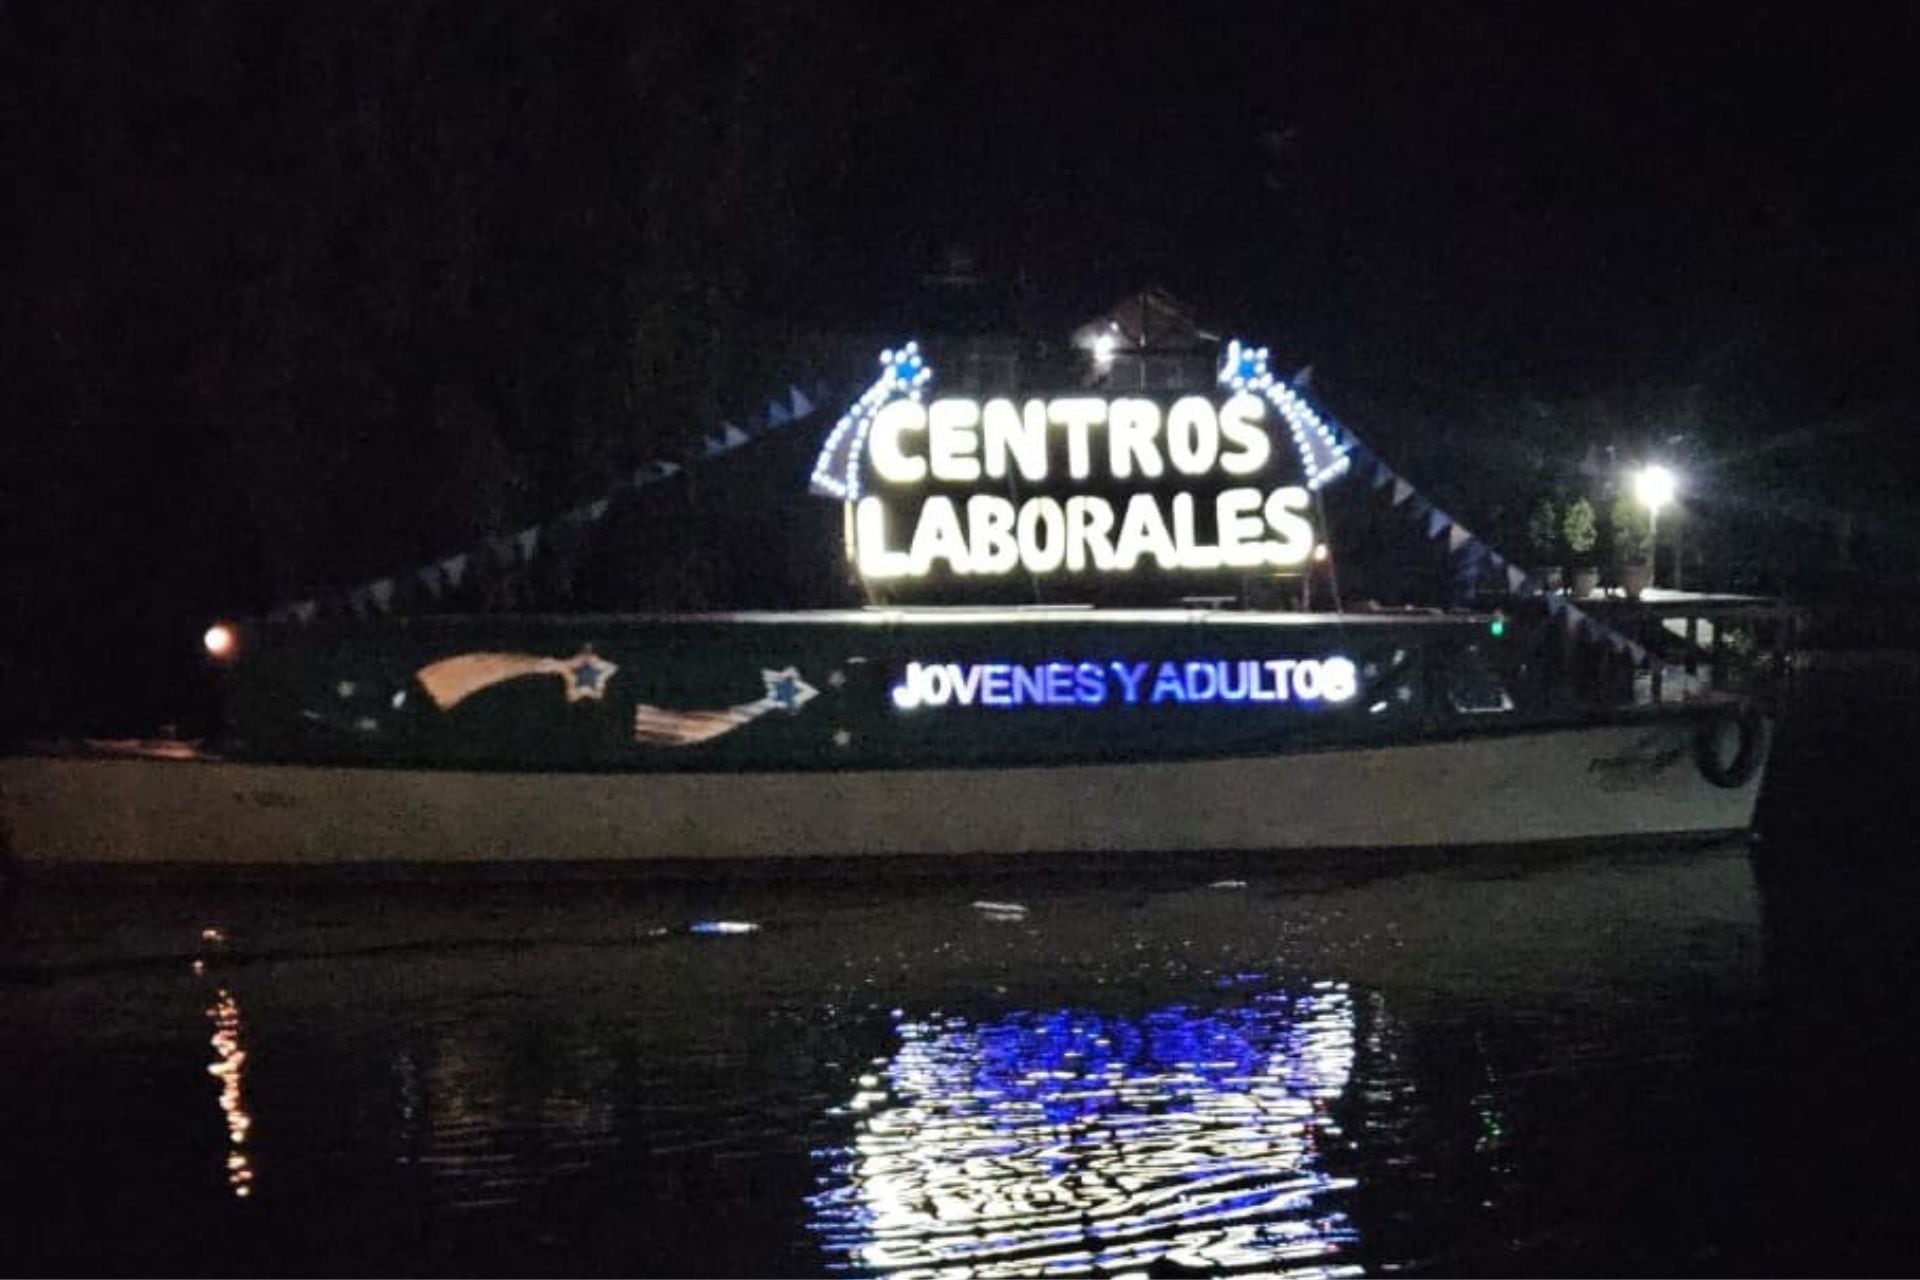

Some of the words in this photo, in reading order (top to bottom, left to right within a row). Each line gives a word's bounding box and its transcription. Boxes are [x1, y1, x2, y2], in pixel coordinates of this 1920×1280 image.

[869, 397, 1271, 481] CENTROS
[857, 487, 1315, 576] LABORALES
[893, 660, 1102, 708] JOVENES
[1110, 662, 1149, 703] Y
[1151, 656, 1356, 702] ADULTOS
